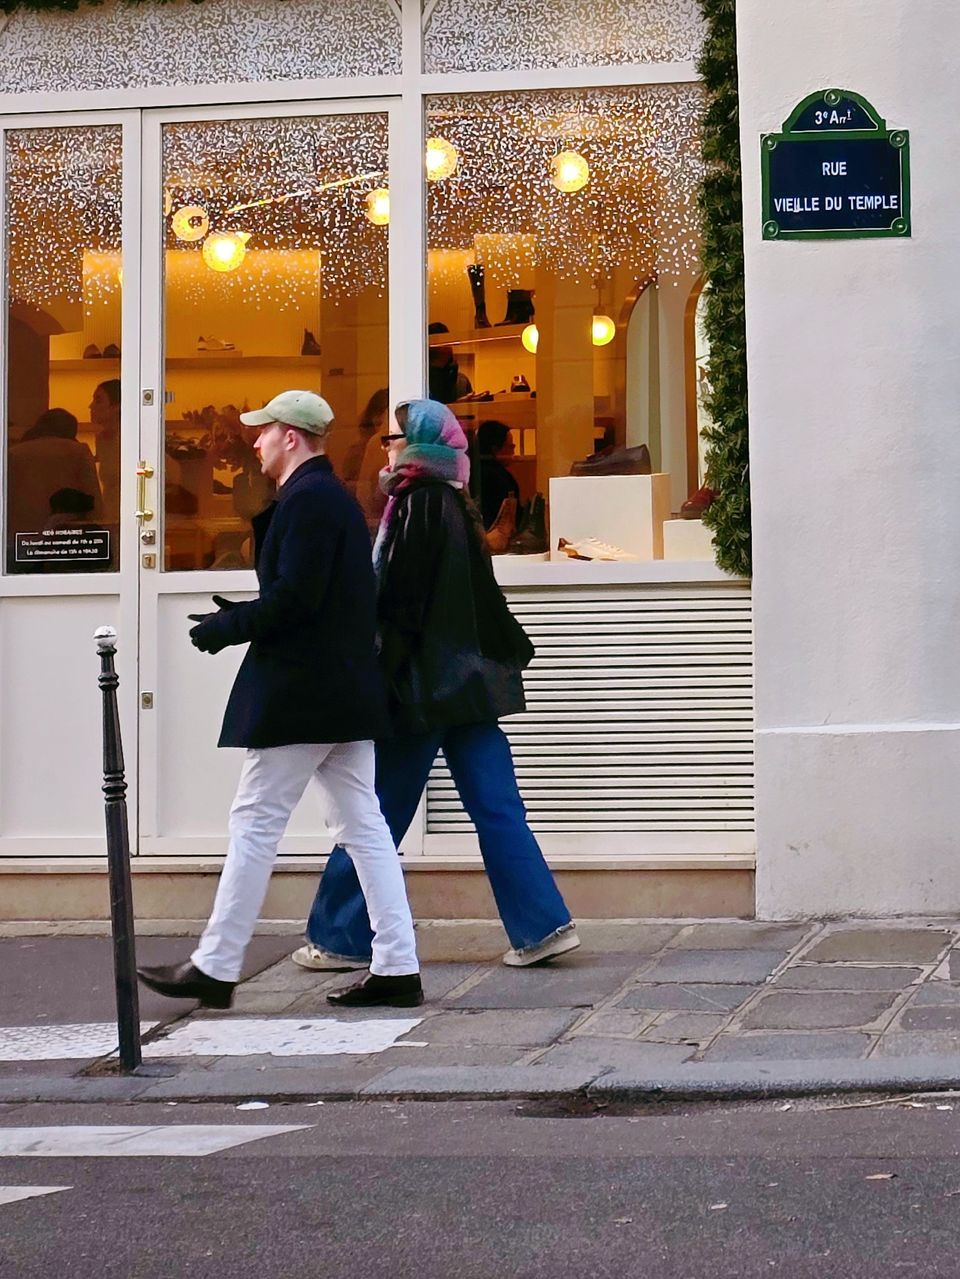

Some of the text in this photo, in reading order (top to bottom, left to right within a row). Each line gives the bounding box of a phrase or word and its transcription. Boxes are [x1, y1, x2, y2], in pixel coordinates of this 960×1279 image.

[822, 161, 847, 176] RUE
[774, 195, 898, 212] VIEILLE DU TEMPLE
